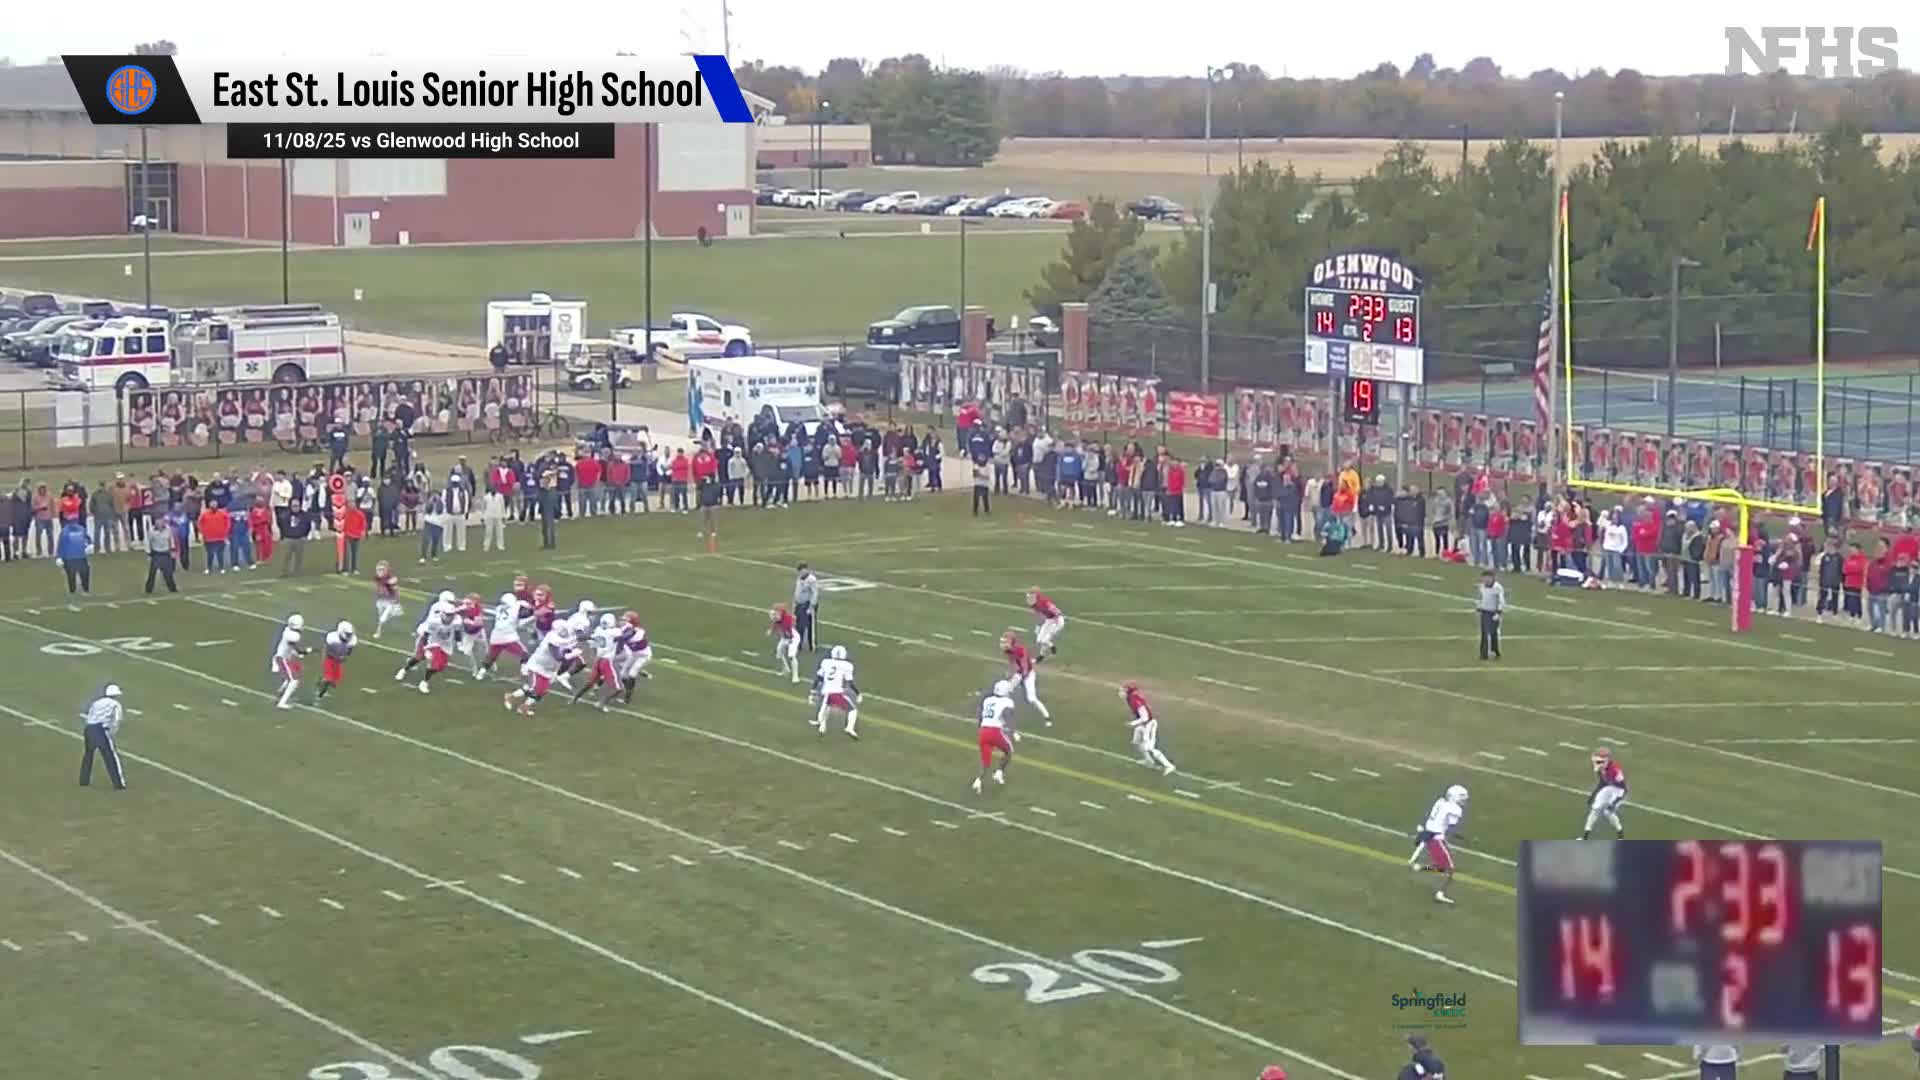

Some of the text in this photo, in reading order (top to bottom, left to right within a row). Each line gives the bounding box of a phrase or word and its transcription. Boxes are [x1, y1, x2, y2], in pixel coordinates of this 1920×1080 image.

[1313, 254, 1413, 290] GLENWOOD
[1339, 277, 1387, 291] TITANS
[1349, 295, 1386, 322] 2:33
[1316, 311, 1334, 333] 14
[1362, 323, 1372, 342] 2
[1395, 317, 1413, 343] 13
[1352, 381, 1372, 412] 19
[971, 949, 1182, 1003] 20
